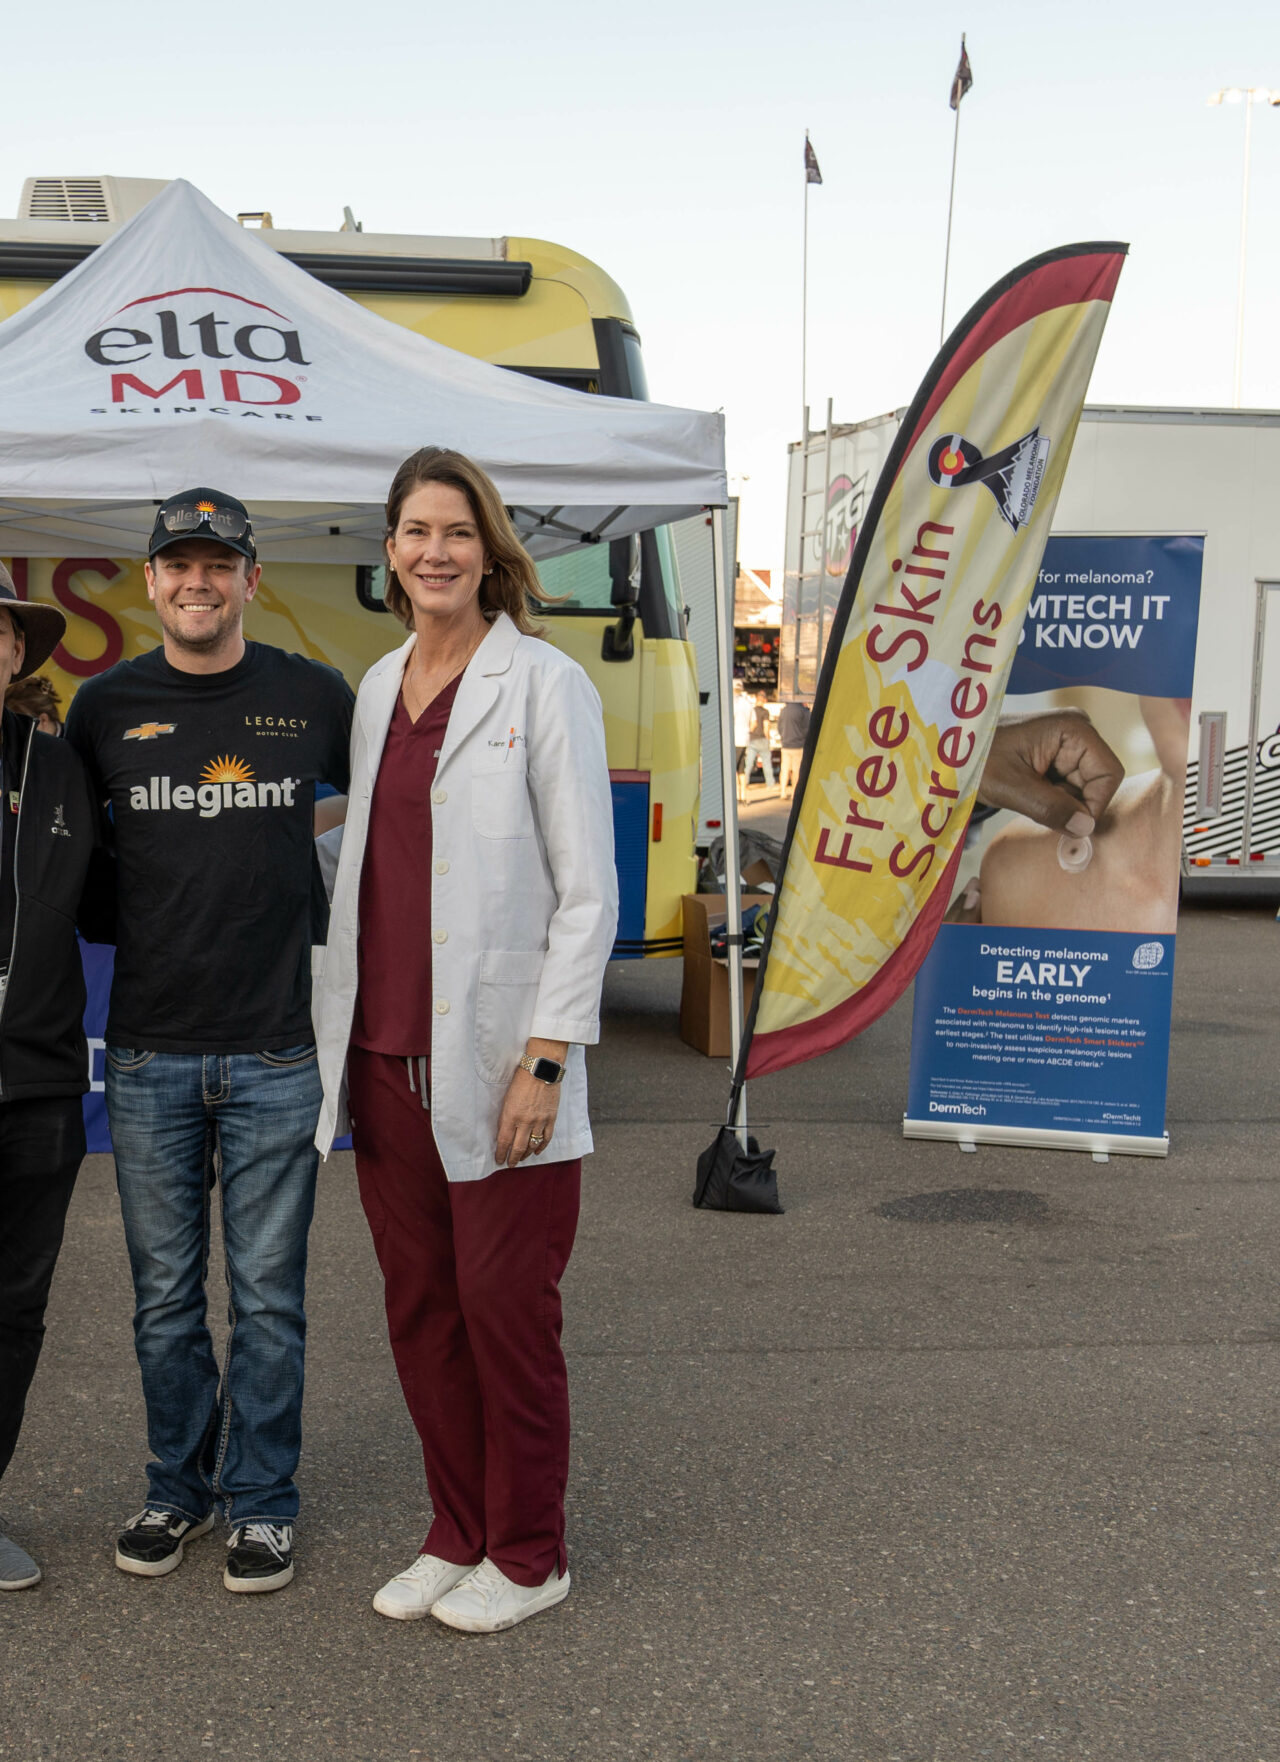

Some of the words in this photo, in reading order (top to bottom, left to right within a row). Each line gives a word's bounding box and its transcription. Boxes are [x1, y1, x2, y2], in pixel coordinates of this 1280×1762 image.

[85, 310, 312, 365] elta
[90, 407, 325, 422] SKINCARE
[1029, 459, 1044, 506] FOUNDATION
[1038, 569, 1060, 583] for
[1065, 569, 1154, 584] melanoma?
[1142, 595, 1170, 620] IT
[1035, 624, 1144, 649] KNOW
[814, 705, 910, 874] Free
[866, 520, 955, 673] Skin
[245, 715, 308, 729] LEGACY
[889, 597, 1003, 883] Screens
[130, 776, 296, 818] allegiant
[980, 944, 1041, 960] Detecting
[1044, 947, 1109, 962] melanoma
[996, 961, 1092, 988] EARLY
[972, 985, 1013, 1000] begins
[1016, 987, 1028, 999] in
[1031, 988, 1051, 1001] the
[943, 1006, 956, 1014] The
[957, 1007, 993, 1016] DermTech
[995, 1010, 1032, 1018] Melanoma
[1051, 1013, 1077, 1021] detects
[1079, 1015, 1109, 1023] genomic
[1111, 1017, 1139, 1025] markers
[935, 1018, 971, 1026] associated
[989, 1020, 1025, 1029] melanoma
[1035, 1024, 1061, 1033] identify
[1063, 1025, 1093, 1034] high-risk
[1095, 1027, 1119, 1035] lesions
[990, 1031, 1003, 1039] The
[1020, 1033, 1043, 1042] utilizes
[1045, 1035, 1081, 1043] DermTech
[1083, 1037, 1106, 1045] Smart
[1046, 1058, 1073, 1066] ABCDE
[1108, 1050, 1132, 1059] lesions
[929, 1101, 987, 1116] DermTech
